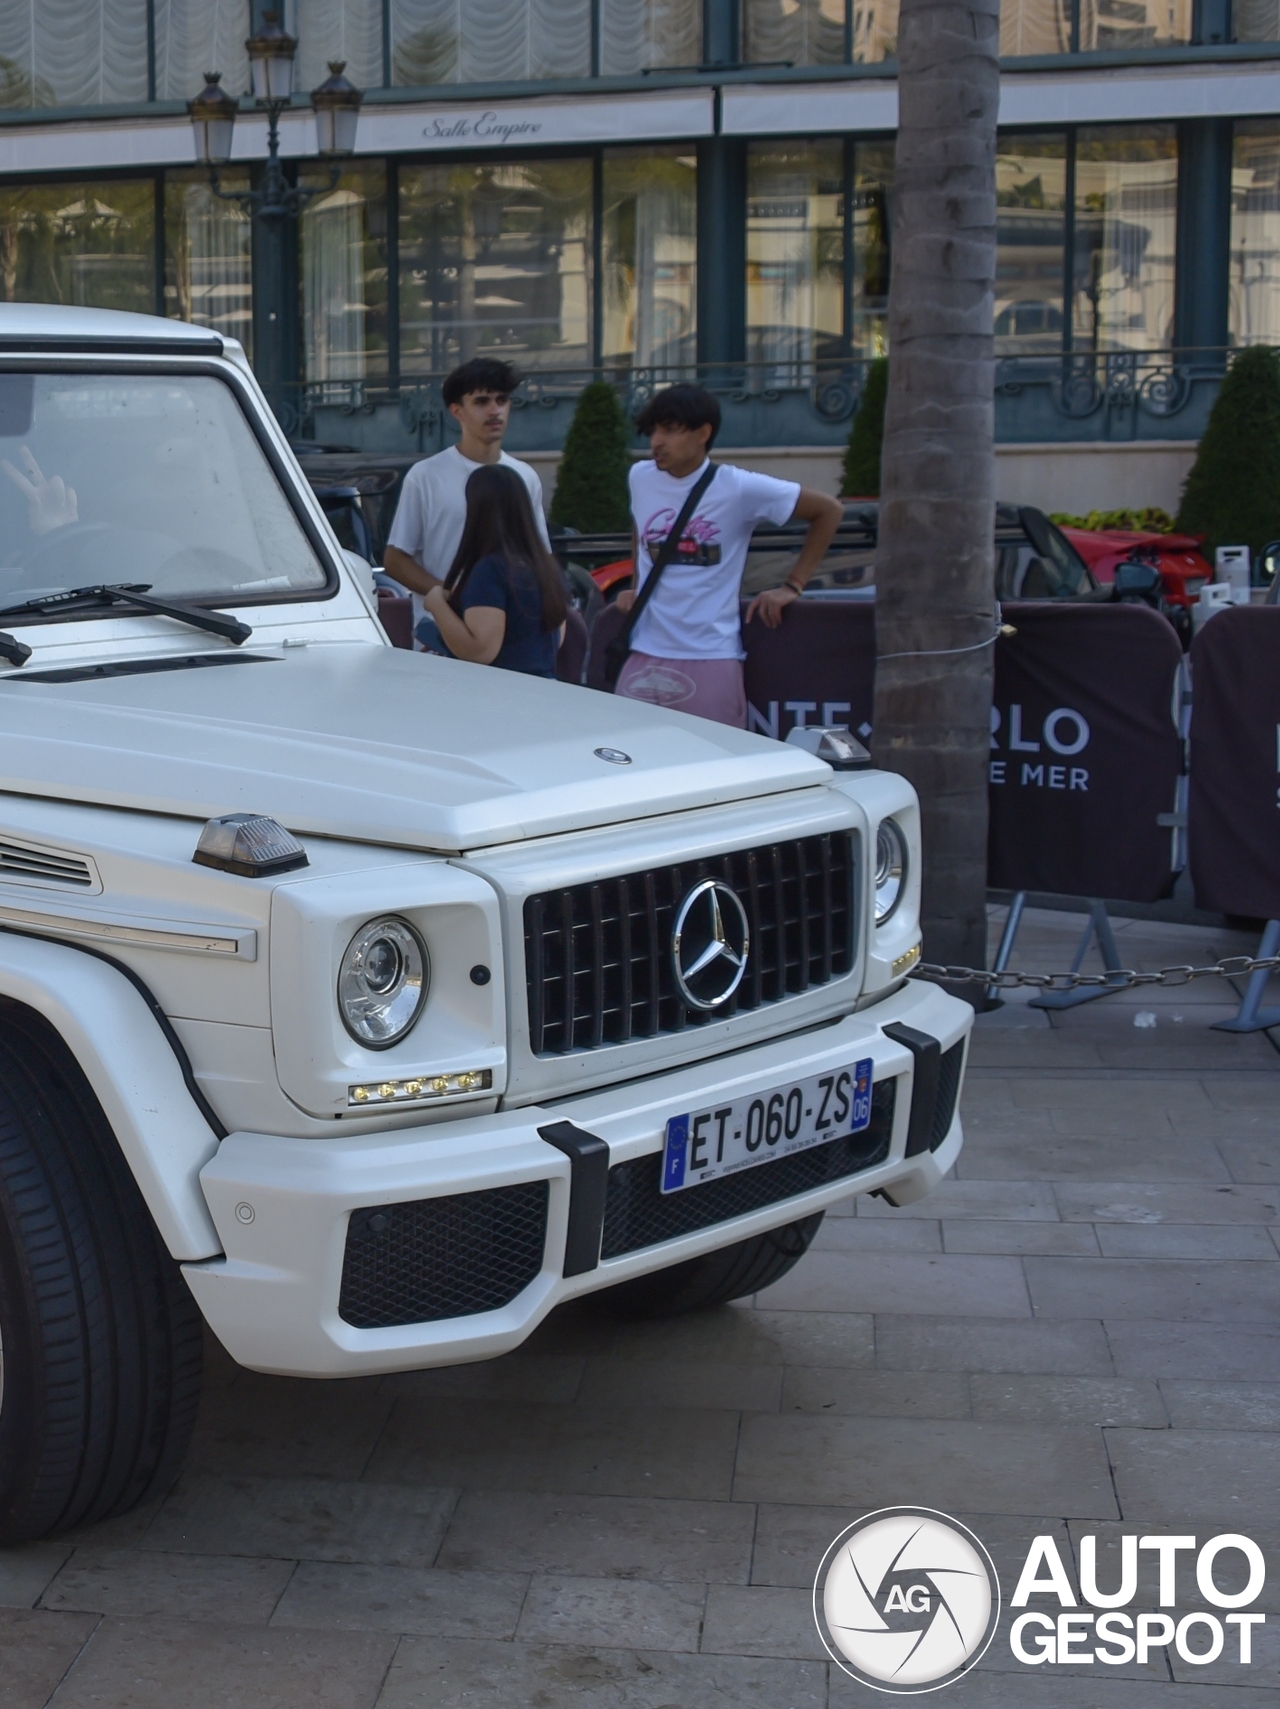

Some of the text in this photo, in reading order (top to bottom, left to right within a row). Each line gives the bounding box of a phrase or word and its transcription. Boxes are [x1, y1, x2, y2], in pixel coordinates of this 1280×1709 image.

[422, 111, 542, 143] Salle Empire
[1022, 763, 1089, 791] MER
[690, 1071, 852, 1171] ET-060-ZS
[853, 1096, 868, 1121] 06
[671, 1158, 680, 1175] F
